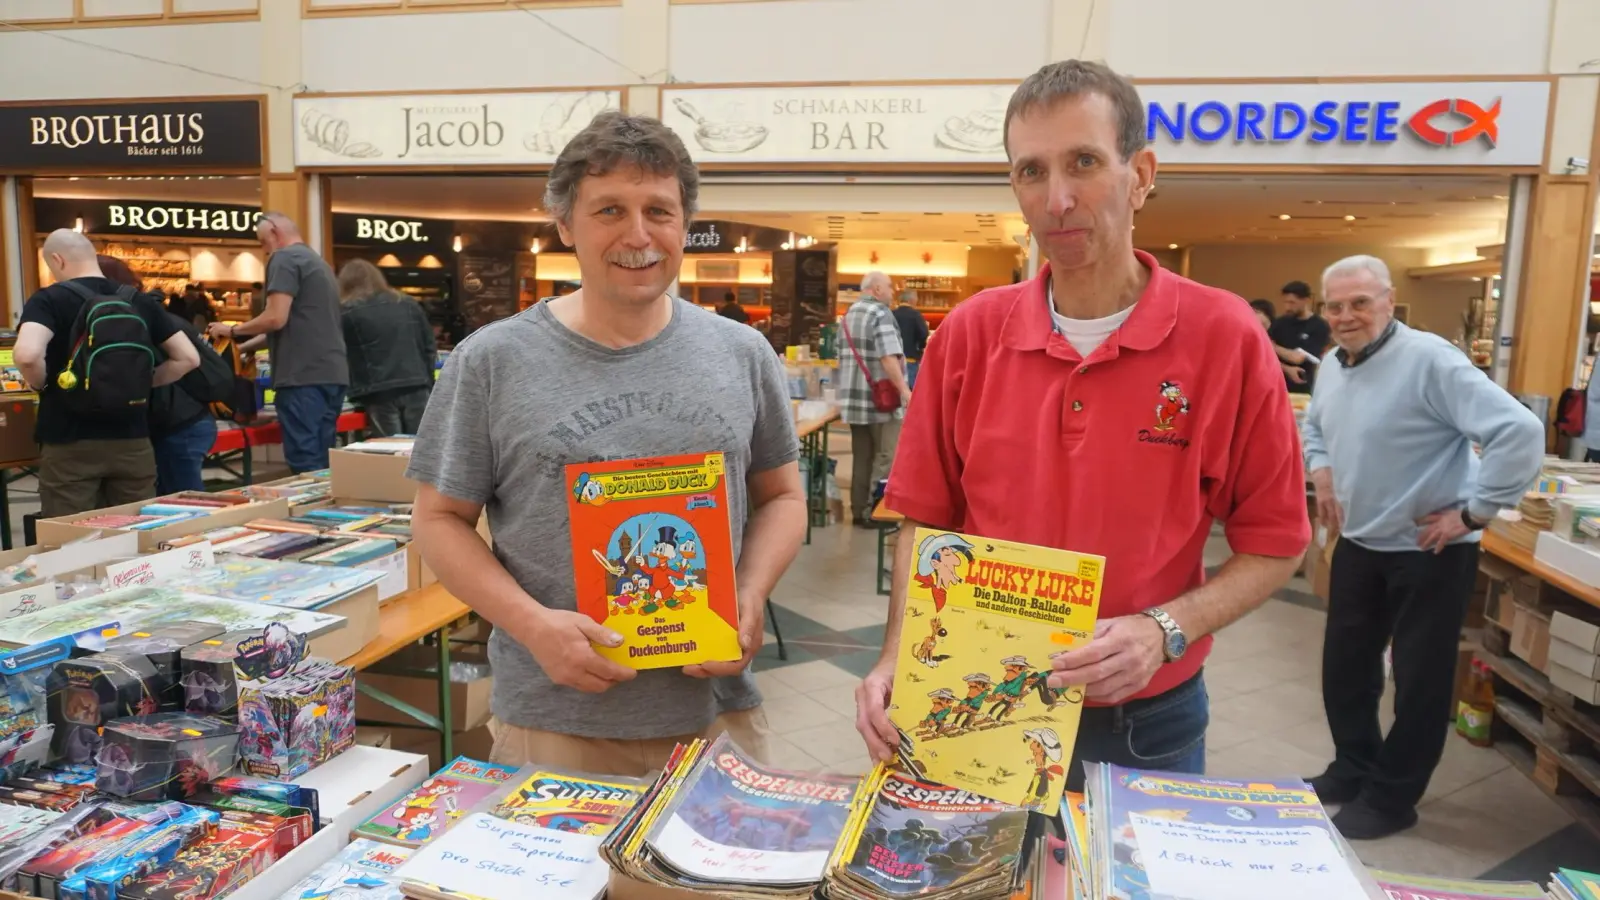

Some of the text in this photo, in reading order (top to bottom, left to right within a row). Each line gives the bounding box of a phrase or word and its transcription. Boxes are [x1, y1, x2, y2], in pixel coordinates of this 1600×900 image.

[773, 98, 927, 115] SCHMANKERL
[30, 112, 204, 148] BROTHAUS
[398, 104, 504, 157] Jacob
[1146, 101, 1399, 142] NORDSEE
[811, 121, 889, 151] BAR
[127, 145, 203, 156] Bäcker seit 1616
[685, 224, 720, 247] acob
[604, 474, 709, 495] DONALD DUCK
[647, 470, 686, 479] Geschichten
[965, 560, 1096, 606] LUCKY LUKE
[973, 587, 1072, 616] Die Dalton-Ballade
[976, 600, 991, 611] und
[991, 603, 1018, 615] andere
[1019, 608, 1065, 624] Geschichten
[637, 622, 685, 637] Gespenst
[629, 640, 697, 658] Duckenburgh
[716, 753, 851, 801] GESPENSTER
[731, 780, 822, 805] GESCHICHTEN
[1162, 783, 1247, 802] DONALD
[1248, 790, 1307, 804] DUCK
[918, 803, 982, 812] GESCHICHTEN
[1135, 817, 1162, 827] Die
[1197, 833, 1247, 845] Donald
[1257, 838, 1299, 846] Duck
[871, 852, 924, 871] GEISTER
[874, 845, 899, 861] DER
[1175, 852, 1234, 868] Stück
[1250, 863, 1275, 872] nur
[869, 858, 913, 878] KAMPF
